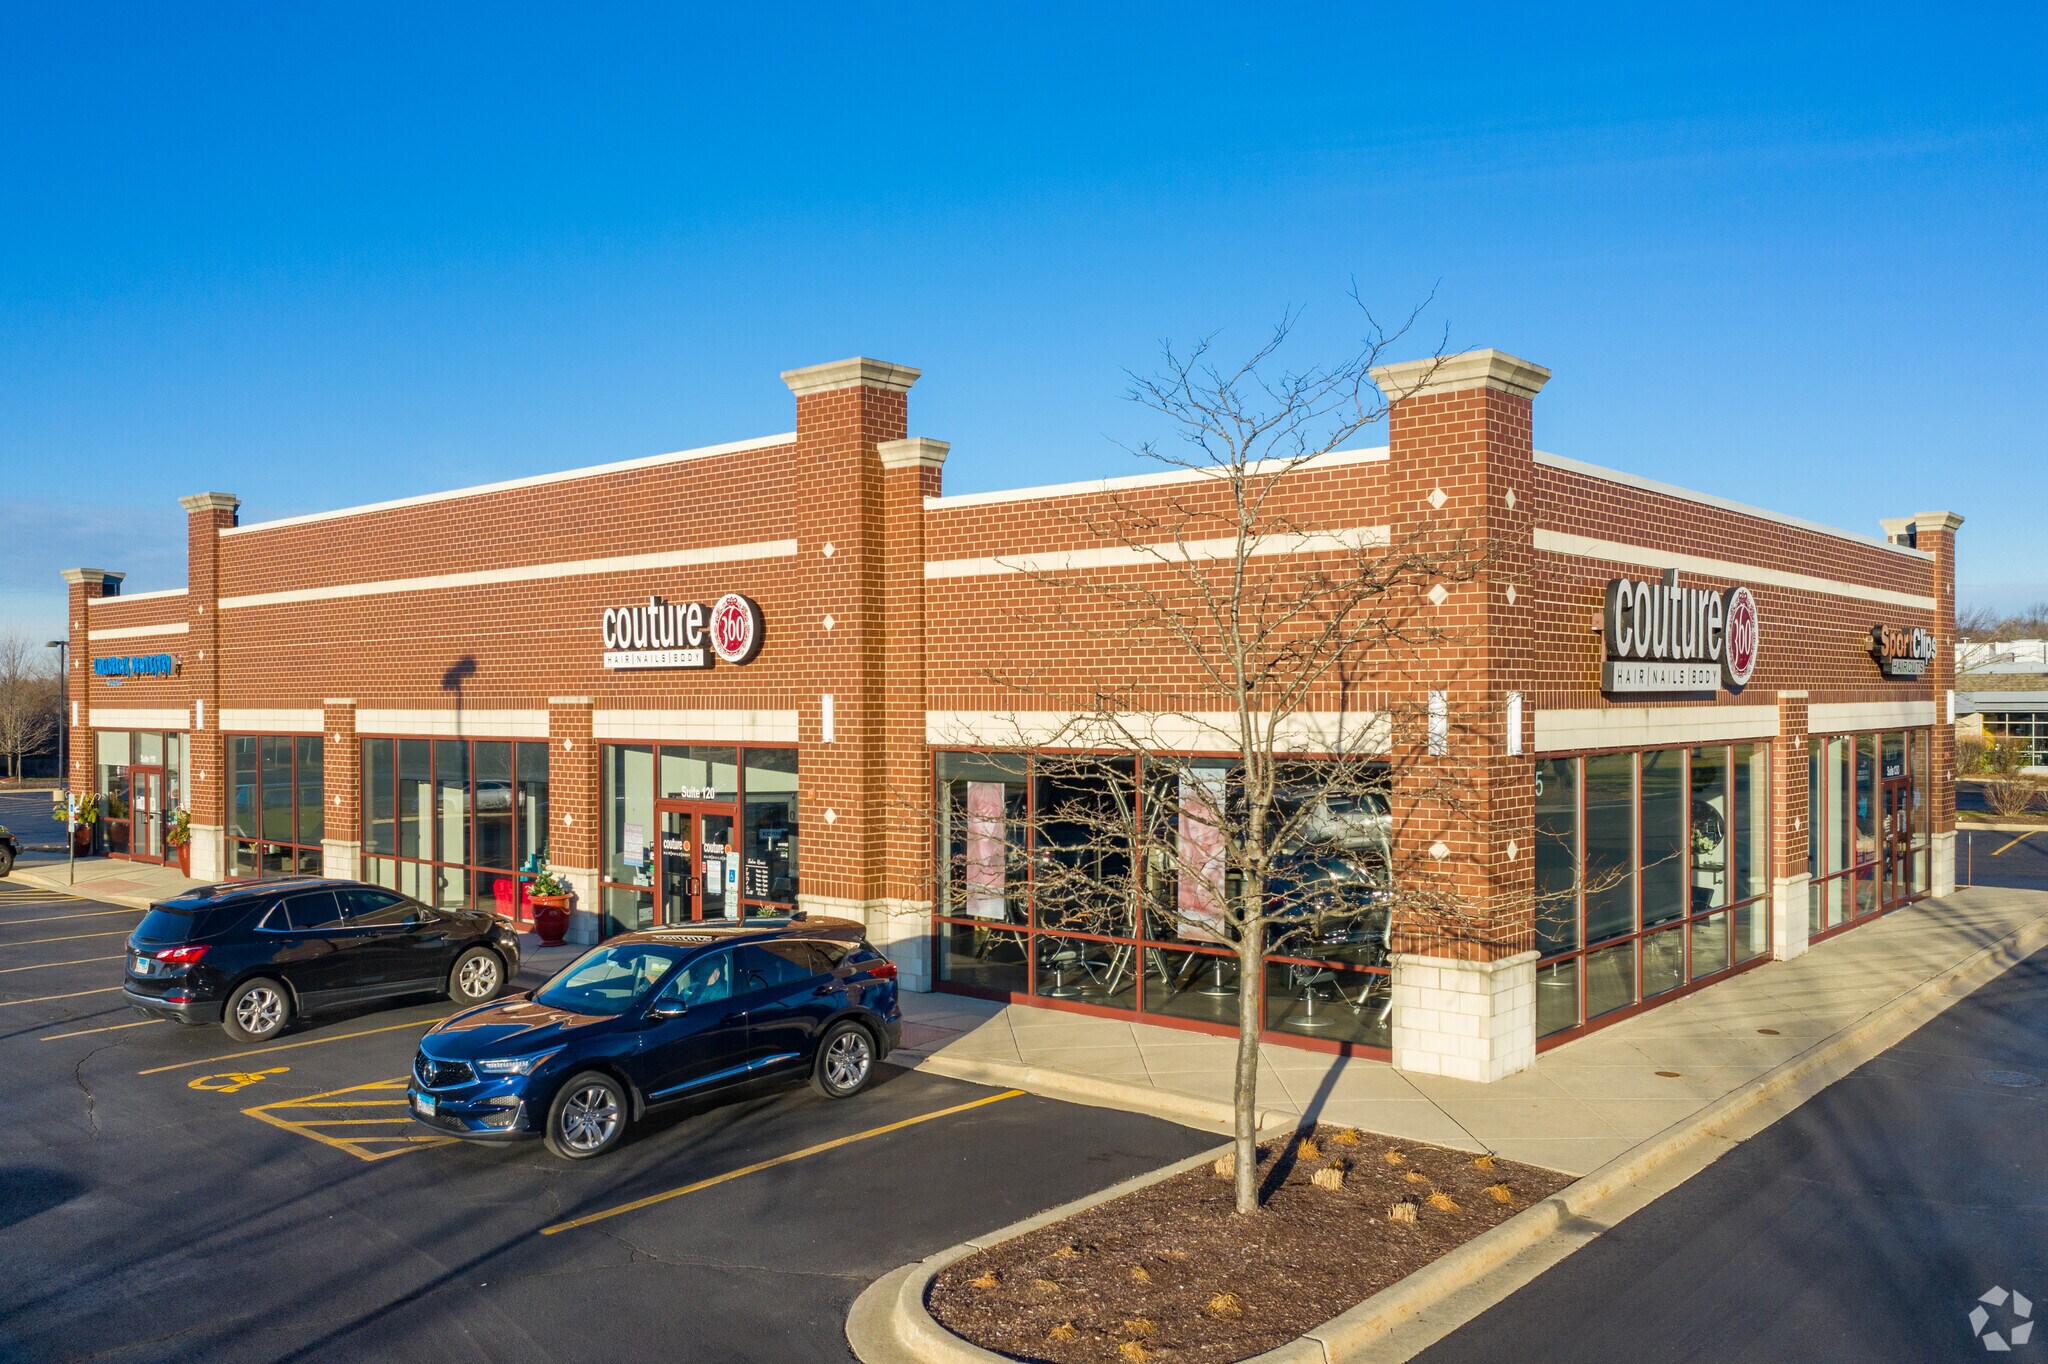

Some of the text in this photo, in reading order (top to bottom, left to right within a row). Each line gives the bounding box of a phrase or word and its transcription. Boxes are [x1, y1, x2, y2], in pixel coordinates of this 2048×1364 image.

[603, 595, 703, 649] couture
[721, 605, 745, 649] 360
[1615, 568, 1722, 660] couture
[1734, 605, 1751, 666] 360
[1617, 669, 1717, 684] HAIR NAILS BODY
[1893, 661, 1924, 673] HAIRCUTS
[681, 786, 715, 799] Suite 120
